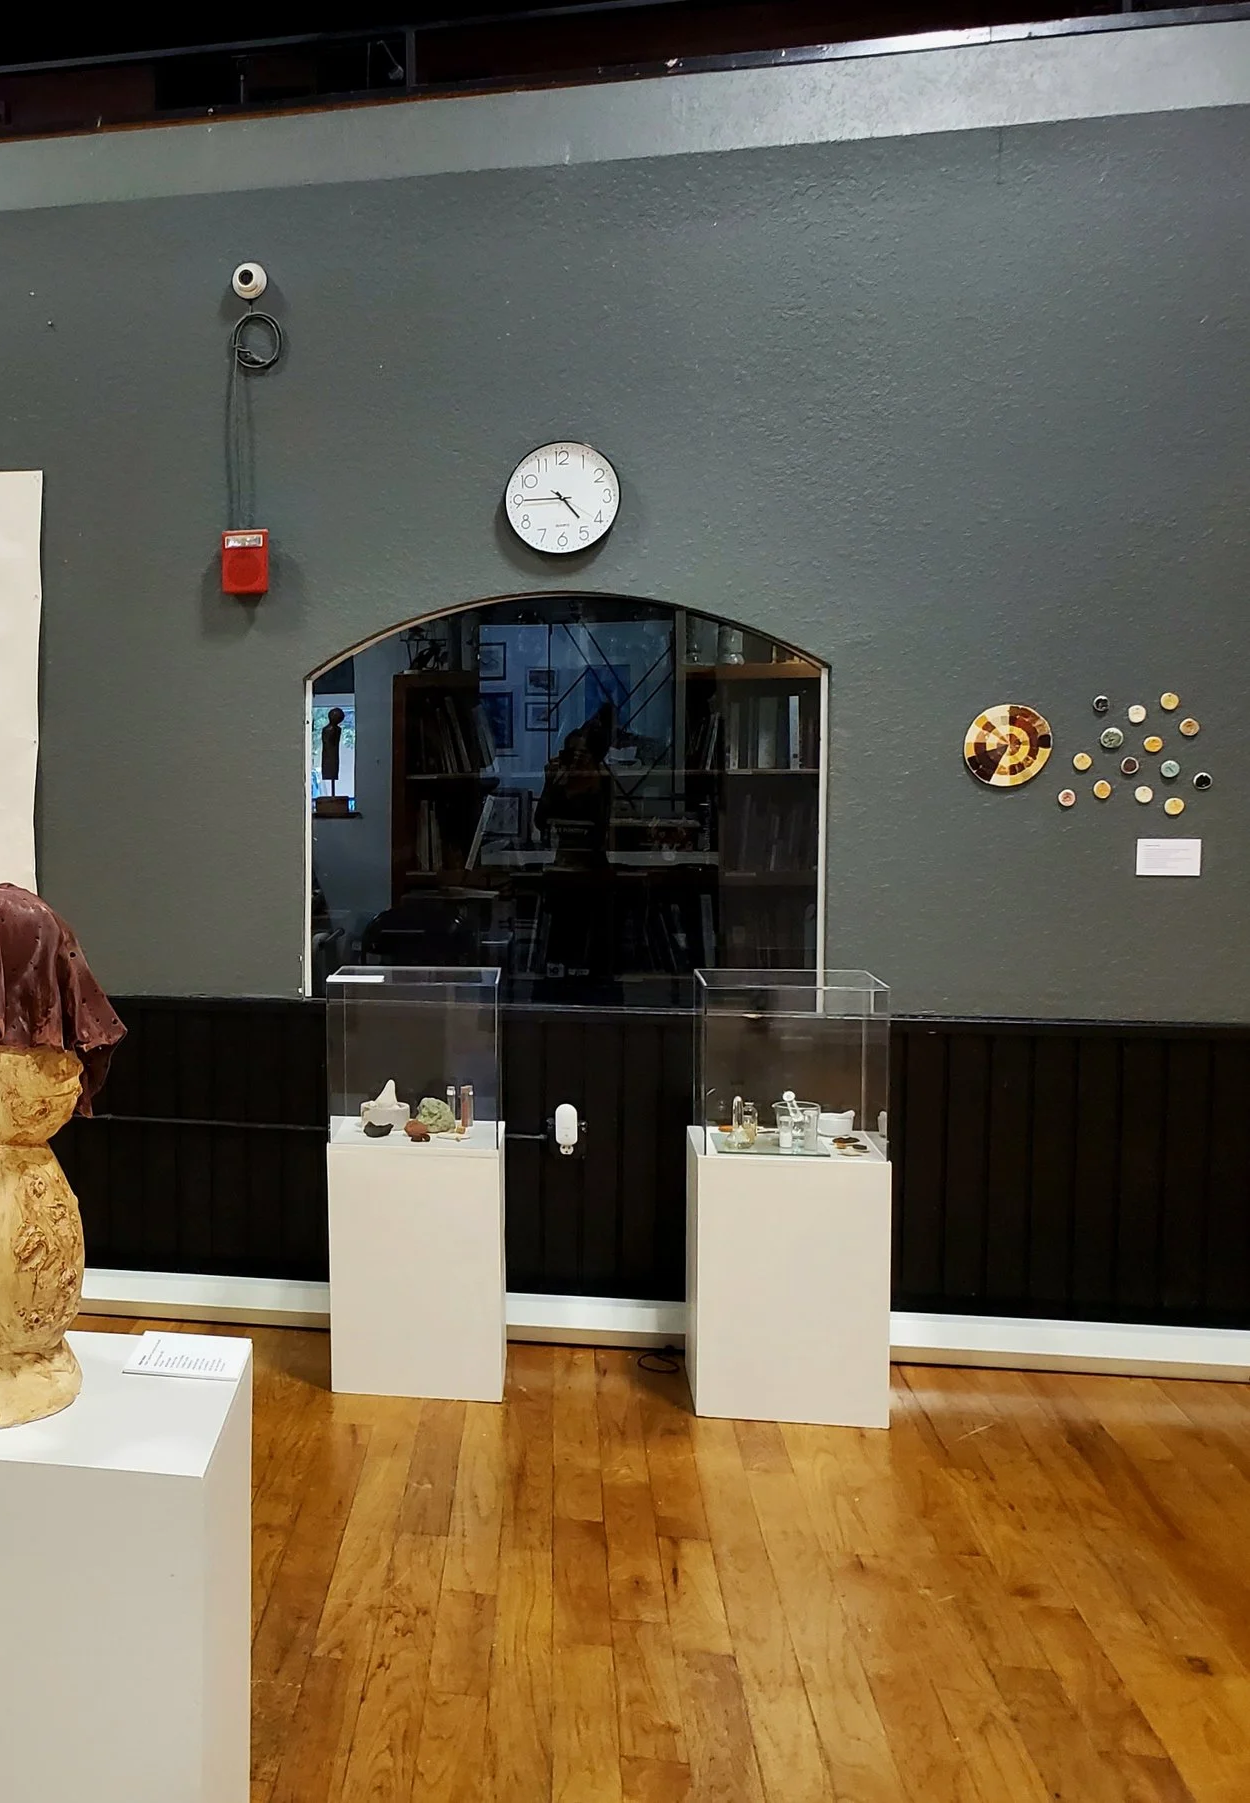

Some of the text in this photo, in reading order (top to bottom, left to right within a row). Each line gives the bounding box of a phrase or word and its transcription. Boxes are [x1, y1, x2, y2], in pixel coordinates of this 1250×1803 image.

[555, 450, 569, 465] 12
[582, 455, 585, 469] 1
[537, 459, 547, 472] 11
[521, 474, 538, 488] 10
[594, 468, 605, 483] 2
[513, 494, 524, 508] 9
[603, 488, 612, 503] 3
[521, 514, 531, 529] 8
[594, 510, 603, 523] 4
[538, 529, 546, 543] 7
[557, 532, 568, 547] 6
[579, 526, 589, 540] 5
